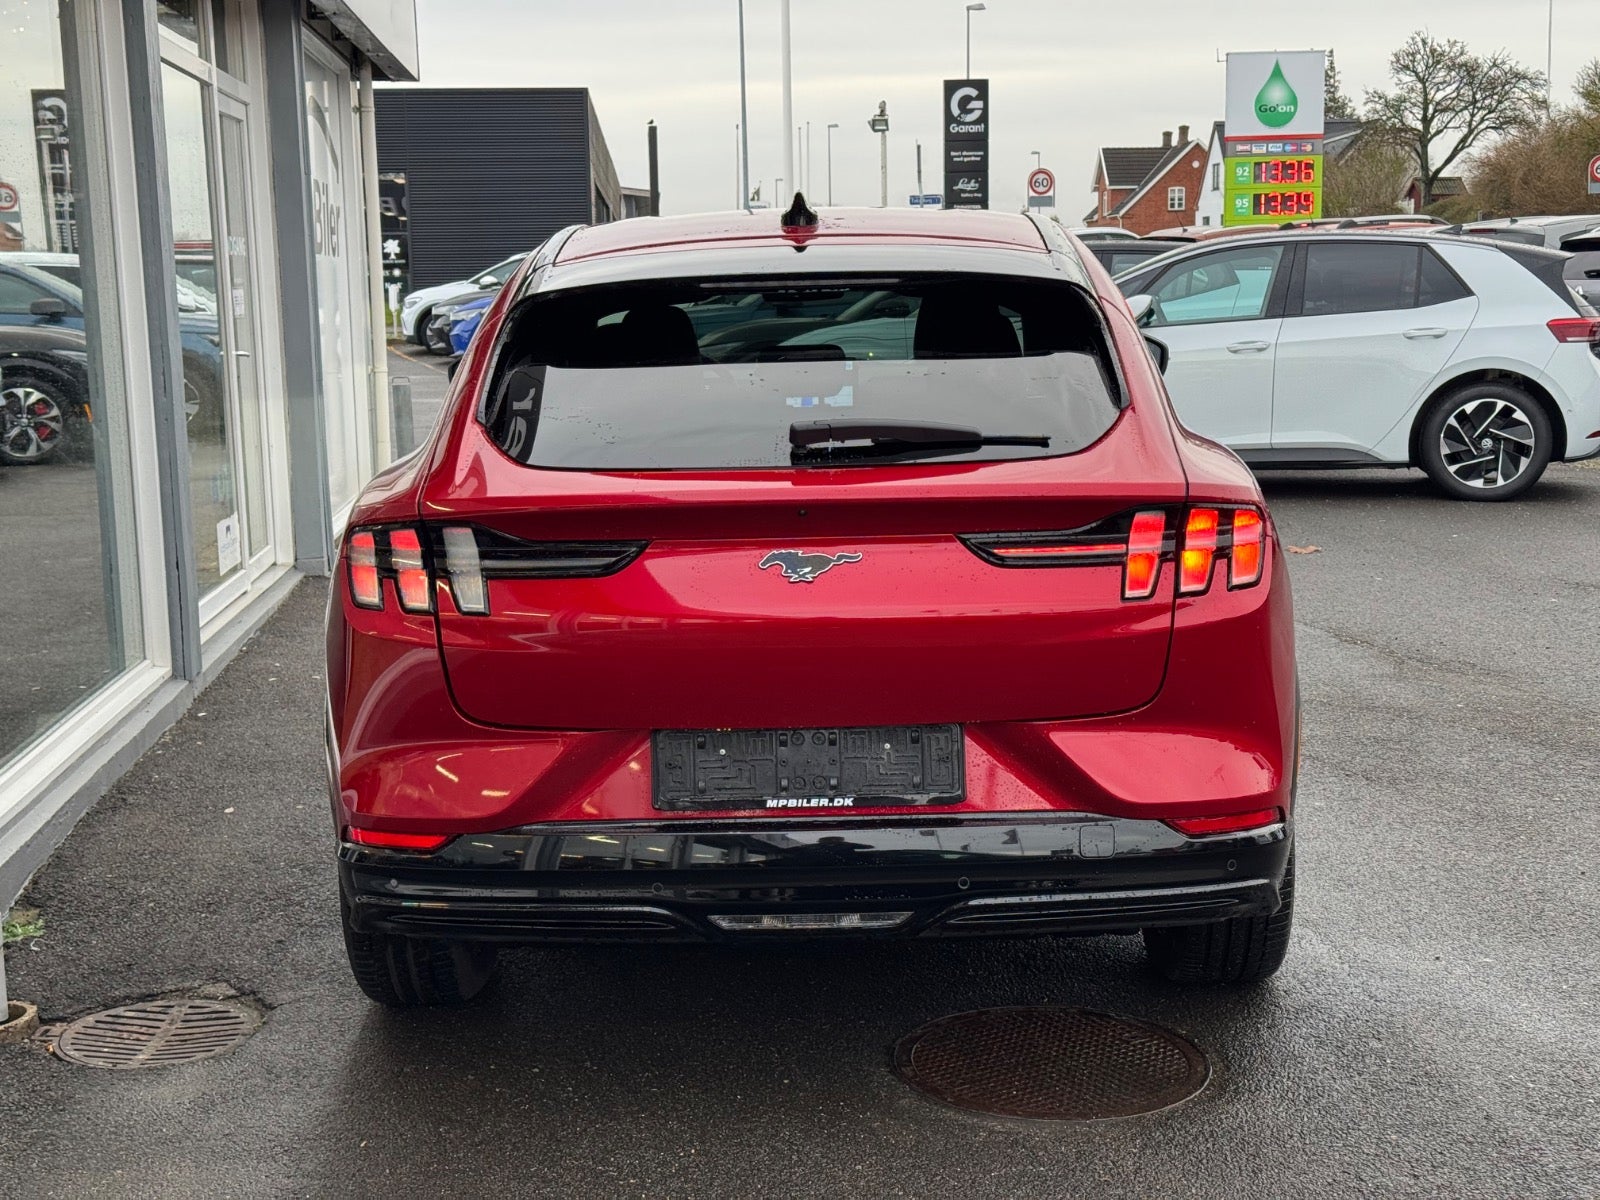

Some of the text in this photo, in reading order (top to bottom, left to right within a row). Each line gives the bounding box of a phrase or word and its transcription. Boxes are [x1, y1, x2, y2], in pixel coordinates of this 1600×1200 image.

[1259, 104, 1294, 113] Go'on
[949, 123, 985, 133] Garant
[1236, 160, 1314, 183] 92 13.36
[1034, 177, 1049, 188] 60
[1235, 192, 1313, 215] 95 13.39
[314, 179, 340, 257] Biler
[766, 798, 854, 807] MPBILER.DK
